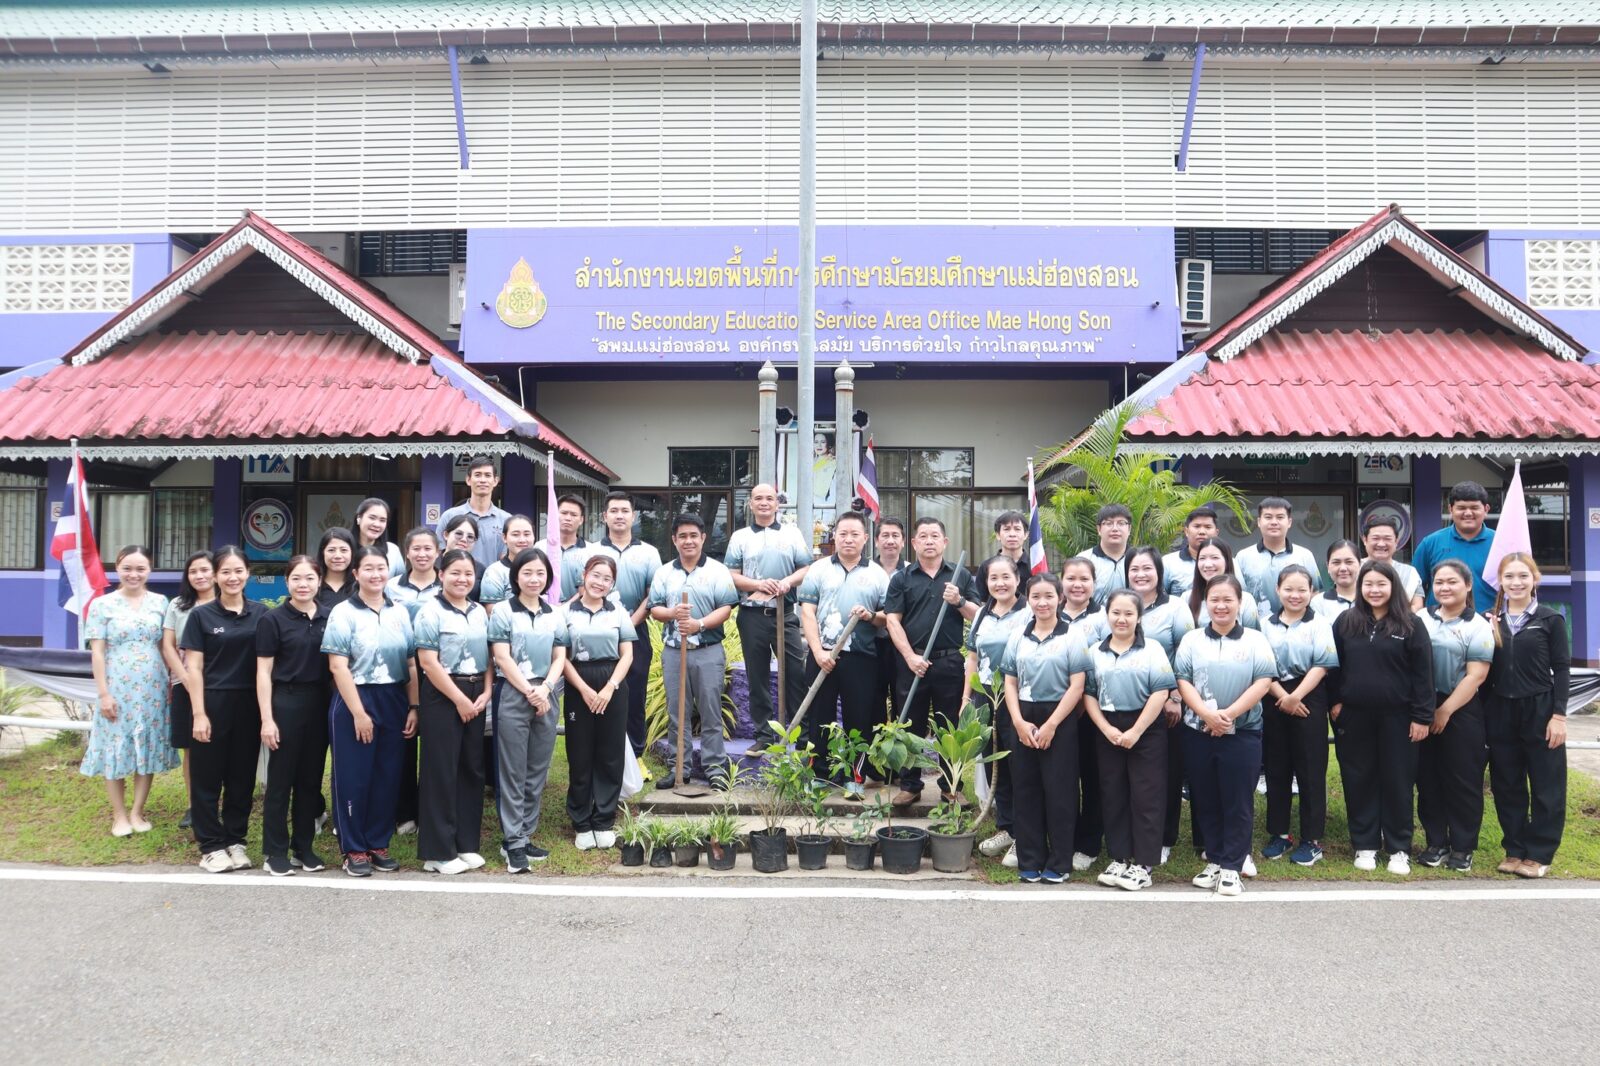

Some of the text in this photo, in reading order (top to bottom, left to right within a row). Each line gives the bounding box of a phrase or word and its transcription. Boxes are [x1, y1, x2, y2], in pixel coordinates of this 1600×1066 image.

[595, 309, 1111, 335] The Secondary Educatio Service Area Office Mae Hong Son
[738, 335, 853, 353] องค์กรสมัย
[858, 334, 962, 353] บริการด้วยใจ
